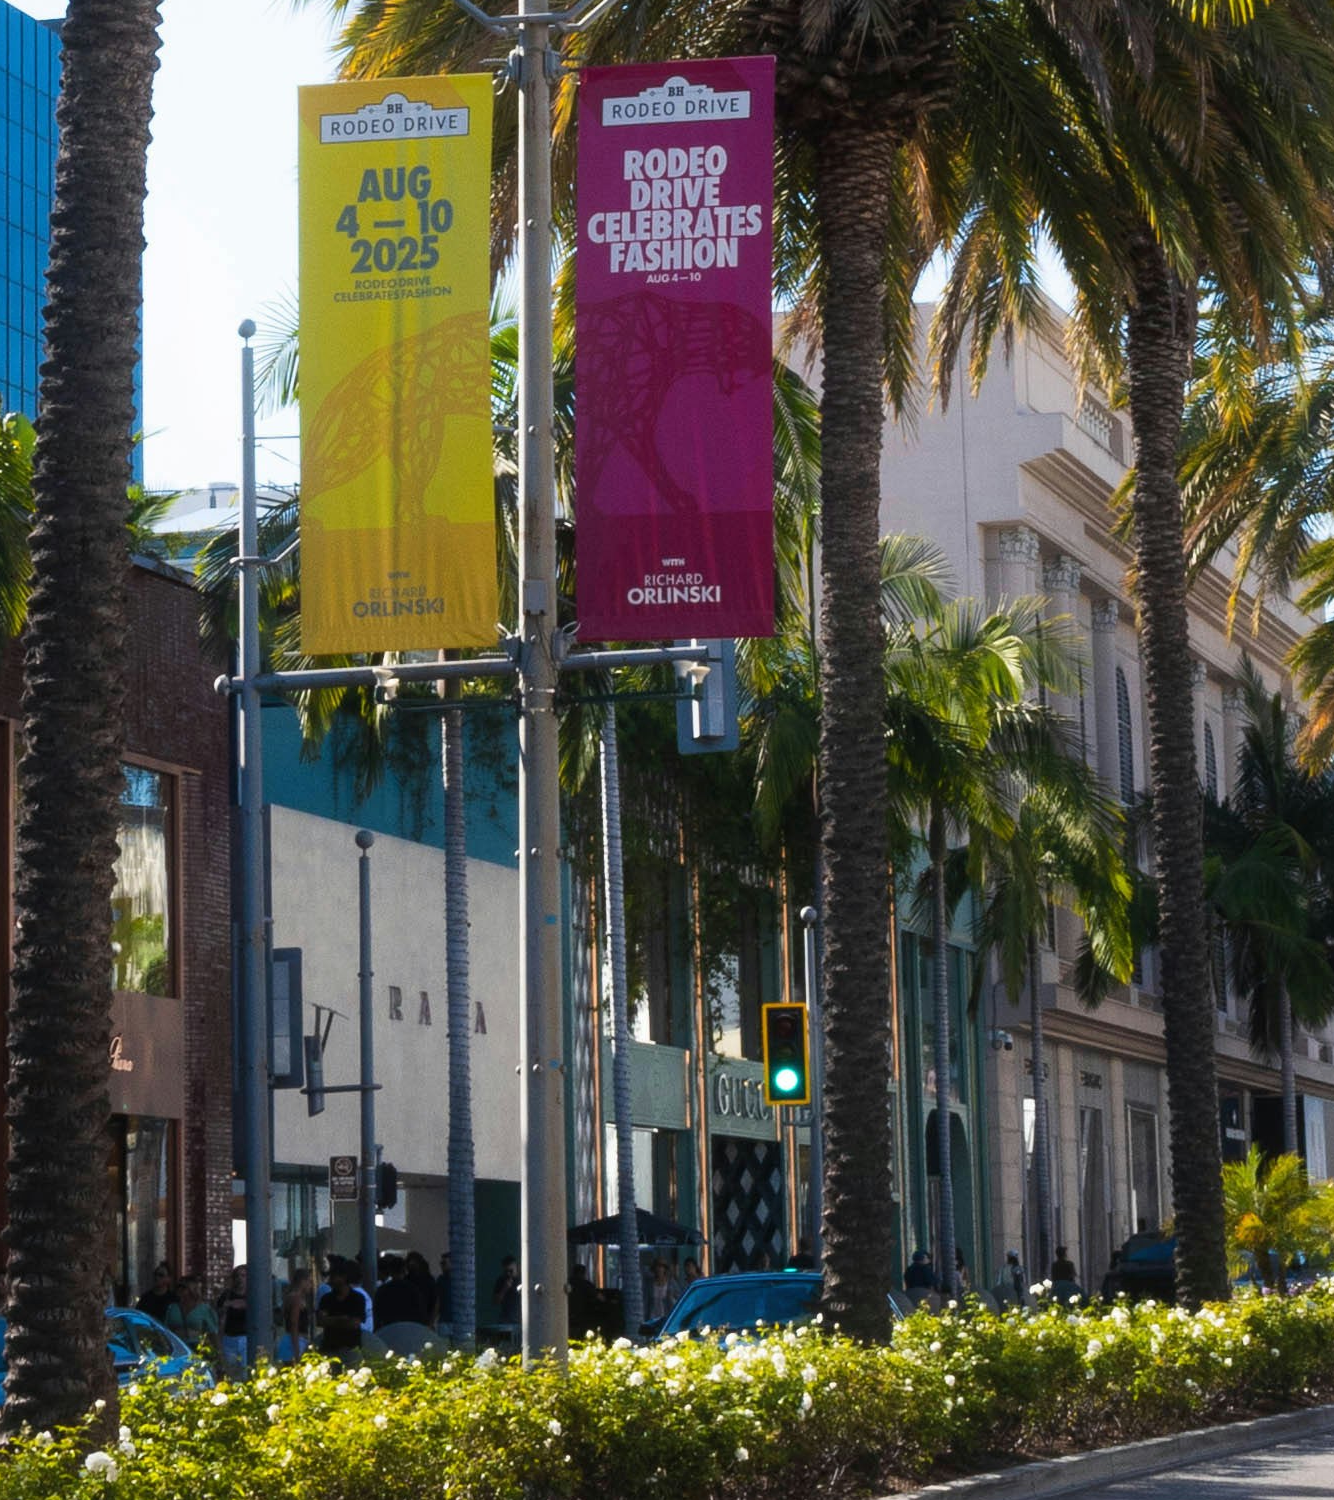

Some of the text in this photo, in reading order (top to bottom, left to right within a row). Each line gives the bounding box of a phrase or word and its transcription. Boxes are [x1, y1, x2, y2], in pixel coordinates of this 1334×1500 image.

[667, 86, 685, 97] BH
[386, 103, 403, 114] BH
[612, 97, 740, 119] RODEO DRIVE
[330, 114, 458, 136] RODEO DRIVE
[623, 145, 727, 180] RODEO
[357, 165, 431, 203] AUG
[630, 177, 720, 211] DRIVE
[587, 205, 763, 243] CELEBRATES
[350, 234, 440, 274] 2025
[609, 237, 739, 273] FASHION
[354, 276, 431, 290] RODEO DRIVE
[646, 273, 670, 284] AUG
[333, 286, 452, 303] CELEBRATES FASHION
[644, 573, 703, 587] RICHARD
[627, 585, 721, 605] ORLINSKI
[352, 598, 445, 619] ORLINSKI
